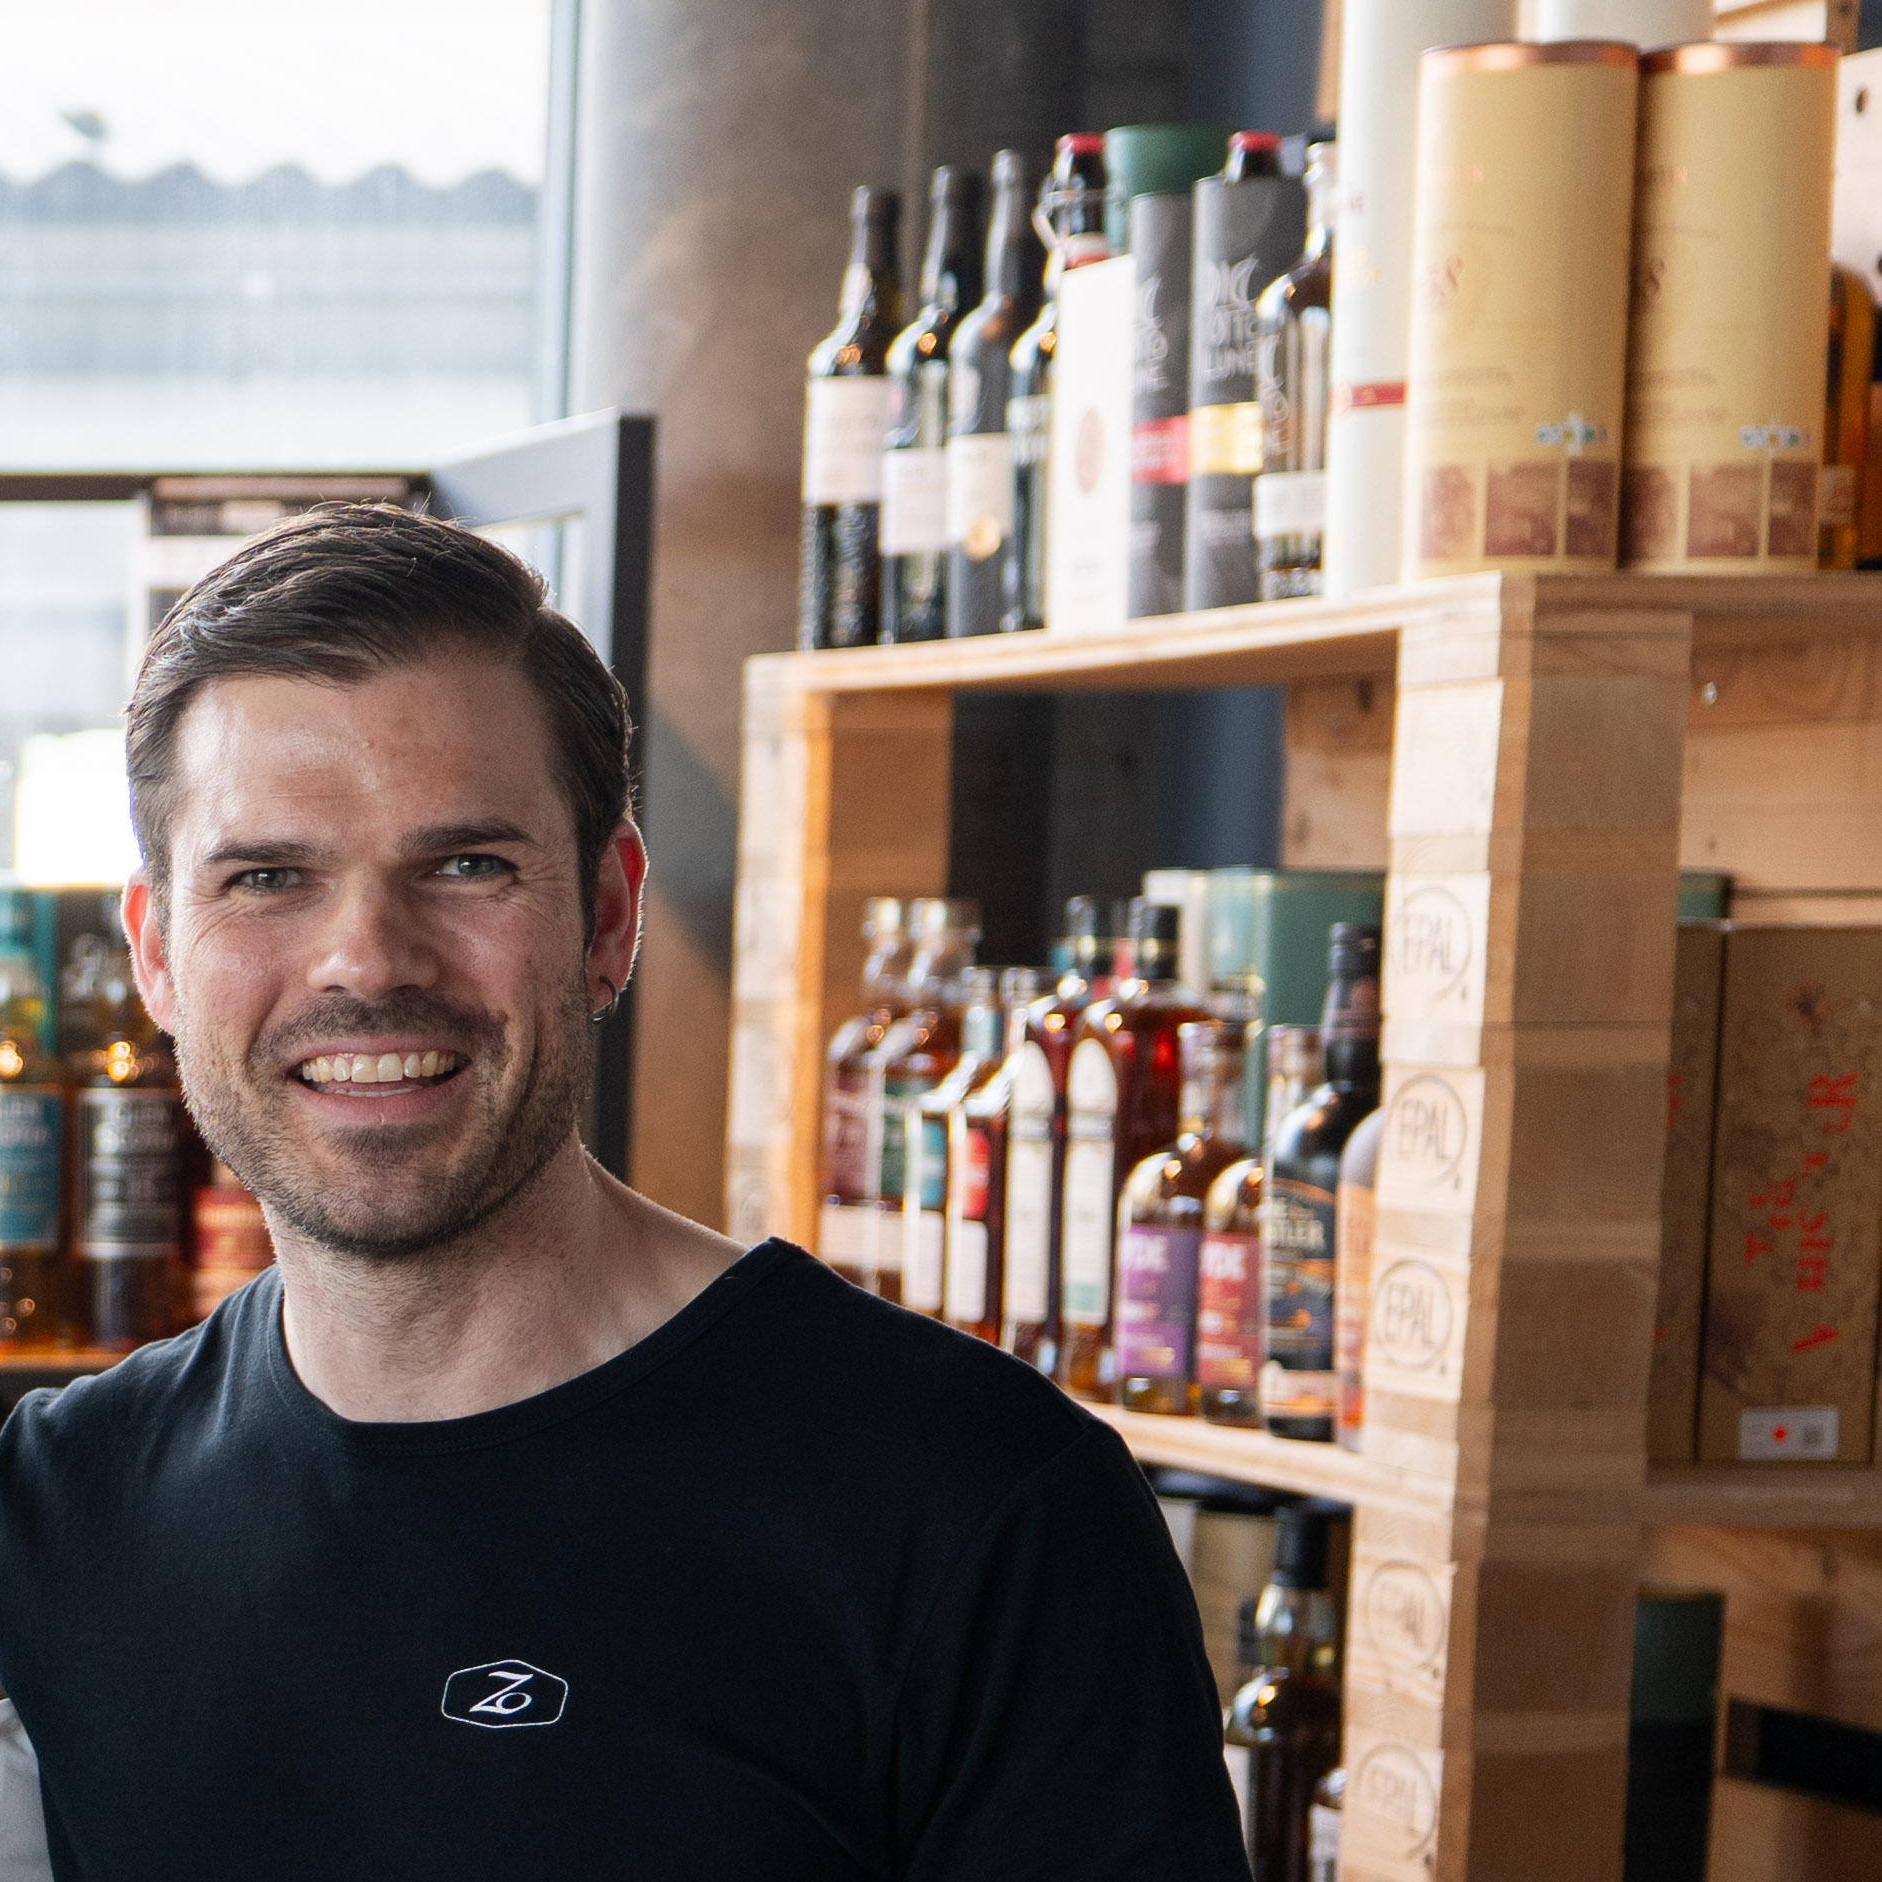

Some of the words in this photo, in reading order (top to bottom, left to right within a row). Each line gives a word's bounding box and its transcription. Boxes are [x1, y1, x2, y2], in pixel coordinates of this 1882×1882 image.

[1401, 913, 1456, 975] EPAL
[1399, 1098, 1453, 1161] EPAL
[1384, 1283, 1436, 1351] EPAL
